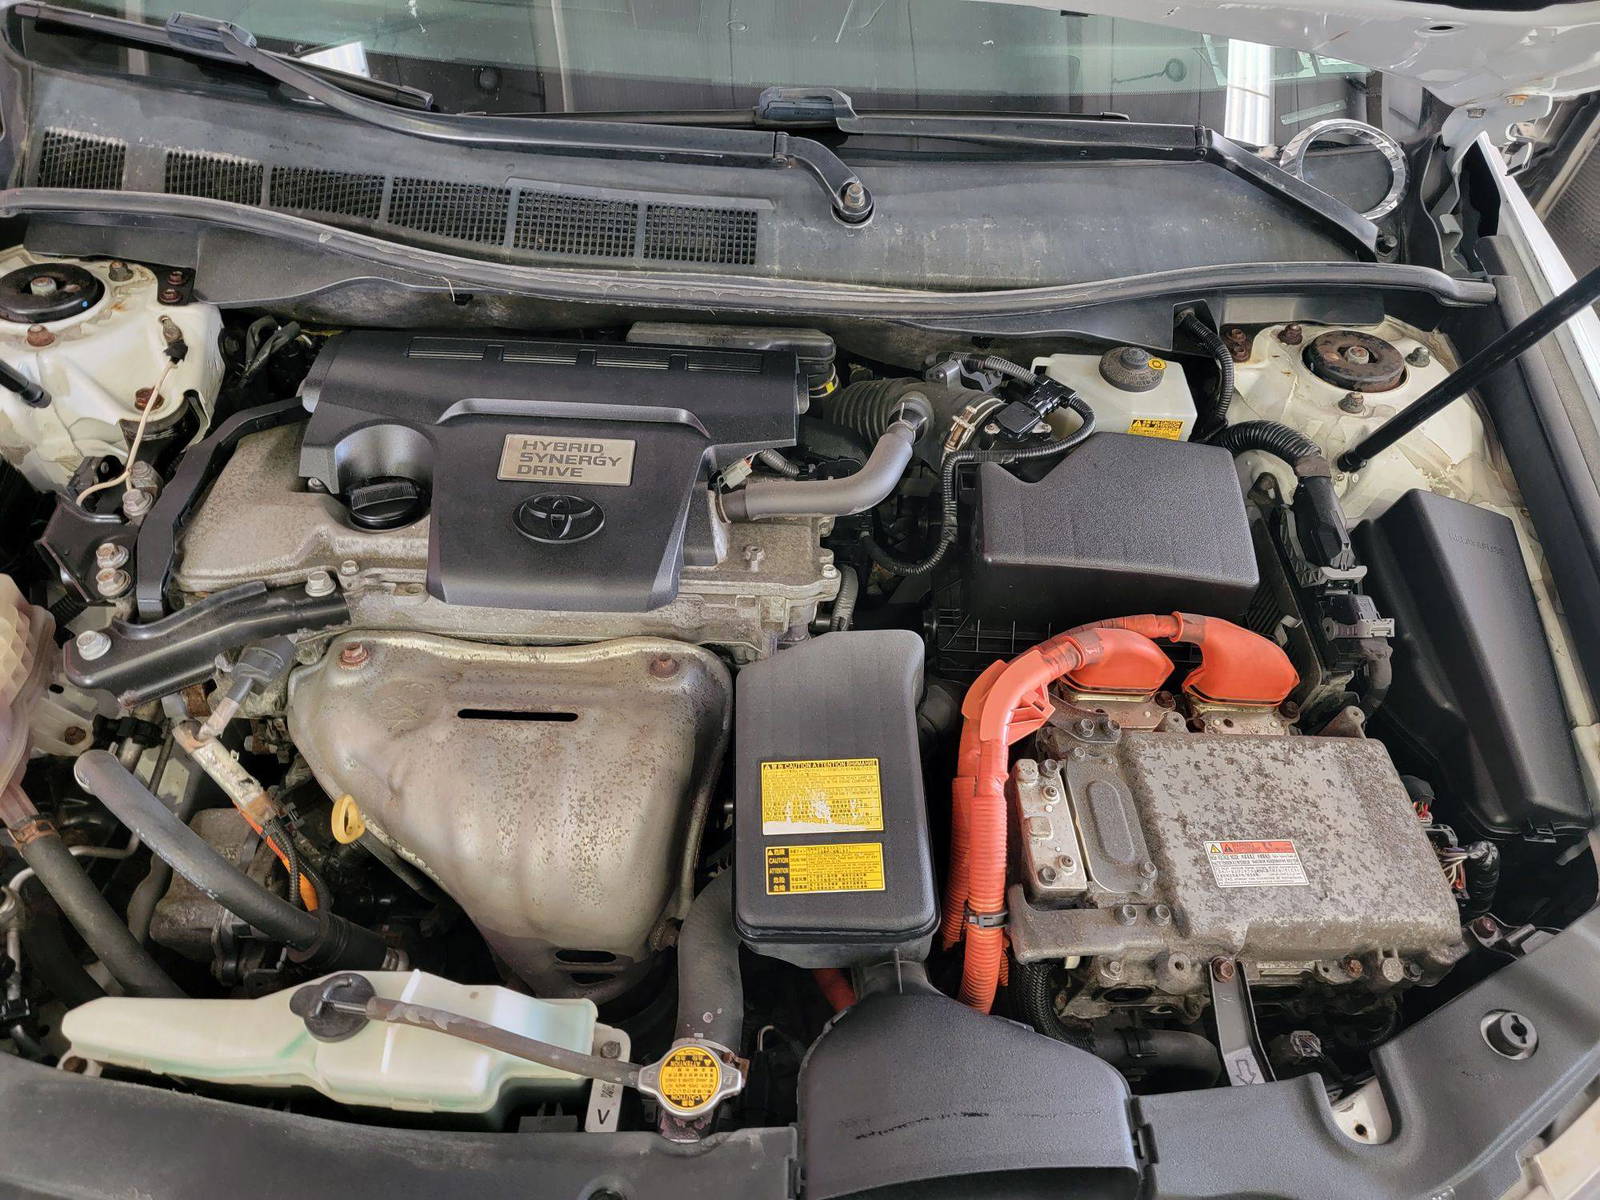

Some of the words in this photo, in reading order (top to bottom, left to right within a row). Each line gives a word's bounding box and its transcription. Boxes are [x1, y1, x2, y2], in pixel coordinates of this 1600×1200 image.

[522, 440, 604, 453] HYBRID
[520, 452, 622, 467] SYNERGY
[517, 464, 584, 477] DRIVE
[812, 761, 846, 769] ATTENTION
